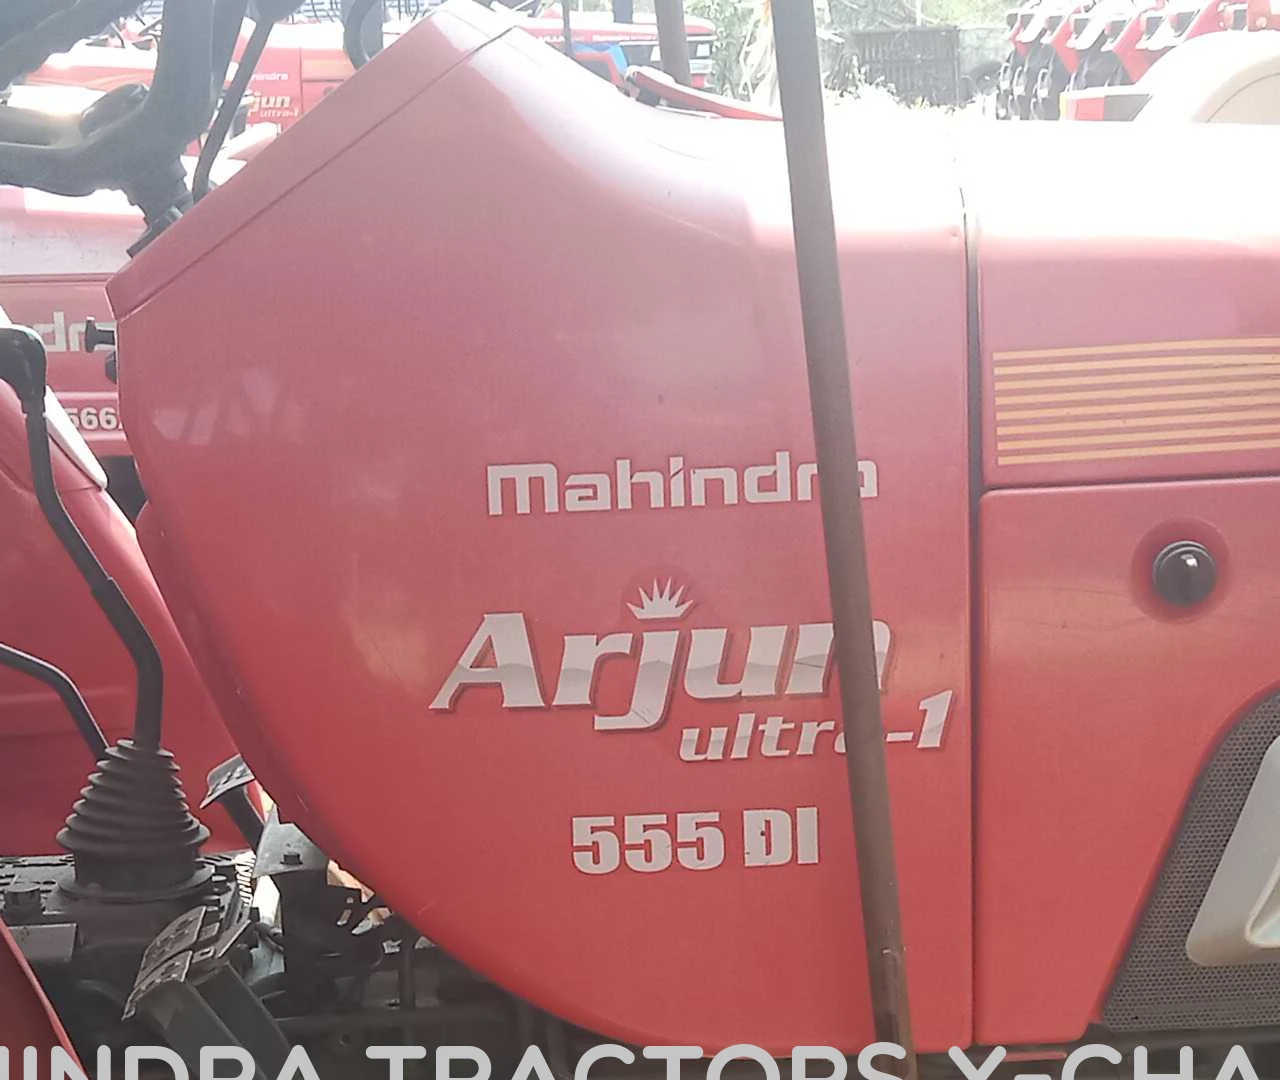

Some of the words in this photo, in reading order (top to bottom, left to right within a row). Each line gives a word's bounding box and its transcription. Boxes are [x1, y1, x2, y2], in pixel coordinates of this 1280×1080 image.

[679, 690, 953, 762] ultr-1
[571, 812, 724, 874] 555
[743, 807, 820, 867] DI
